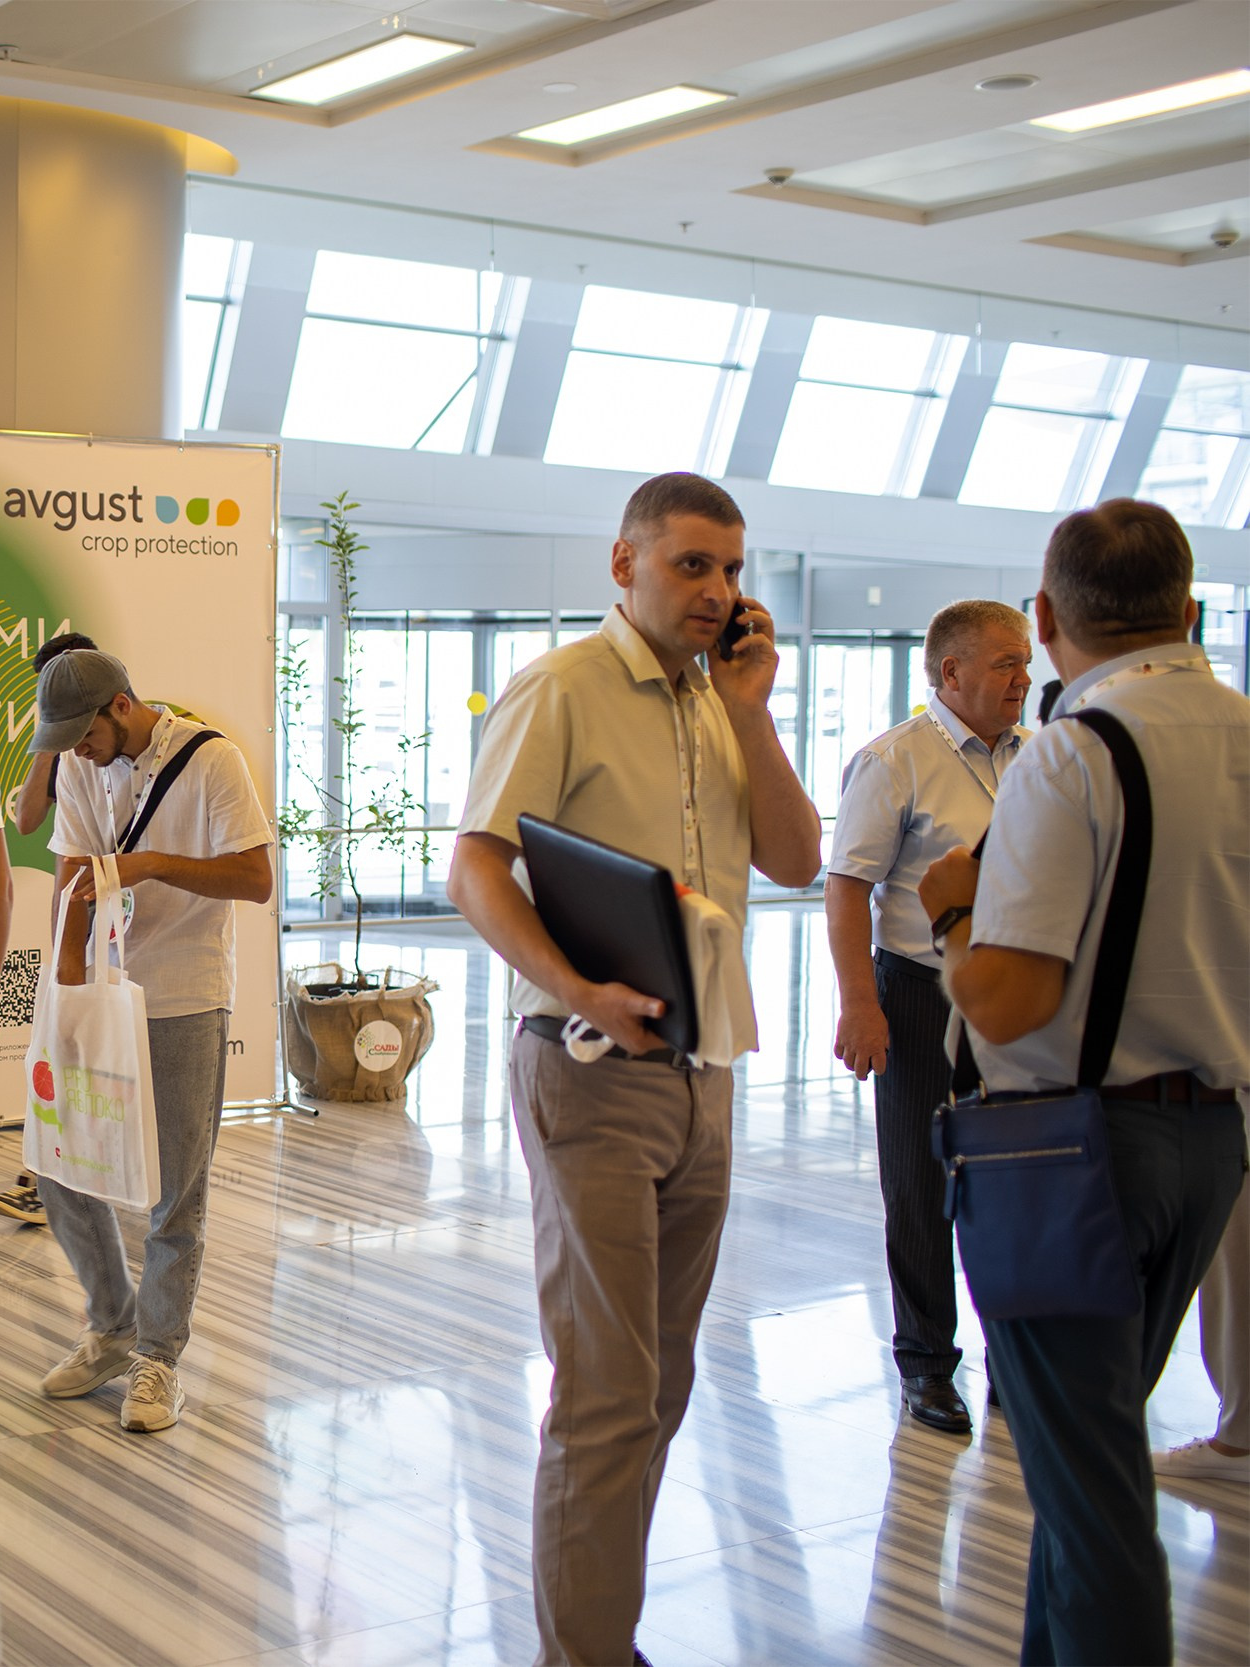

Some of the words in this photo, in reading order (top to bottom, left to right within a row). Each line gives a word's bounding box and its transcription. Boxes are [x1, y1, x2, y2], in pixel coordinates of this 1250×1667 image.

[3, 485, 143, 531] avgust
[81, 535, 129, 557] crop
[134, 535, 238, 558] protection
